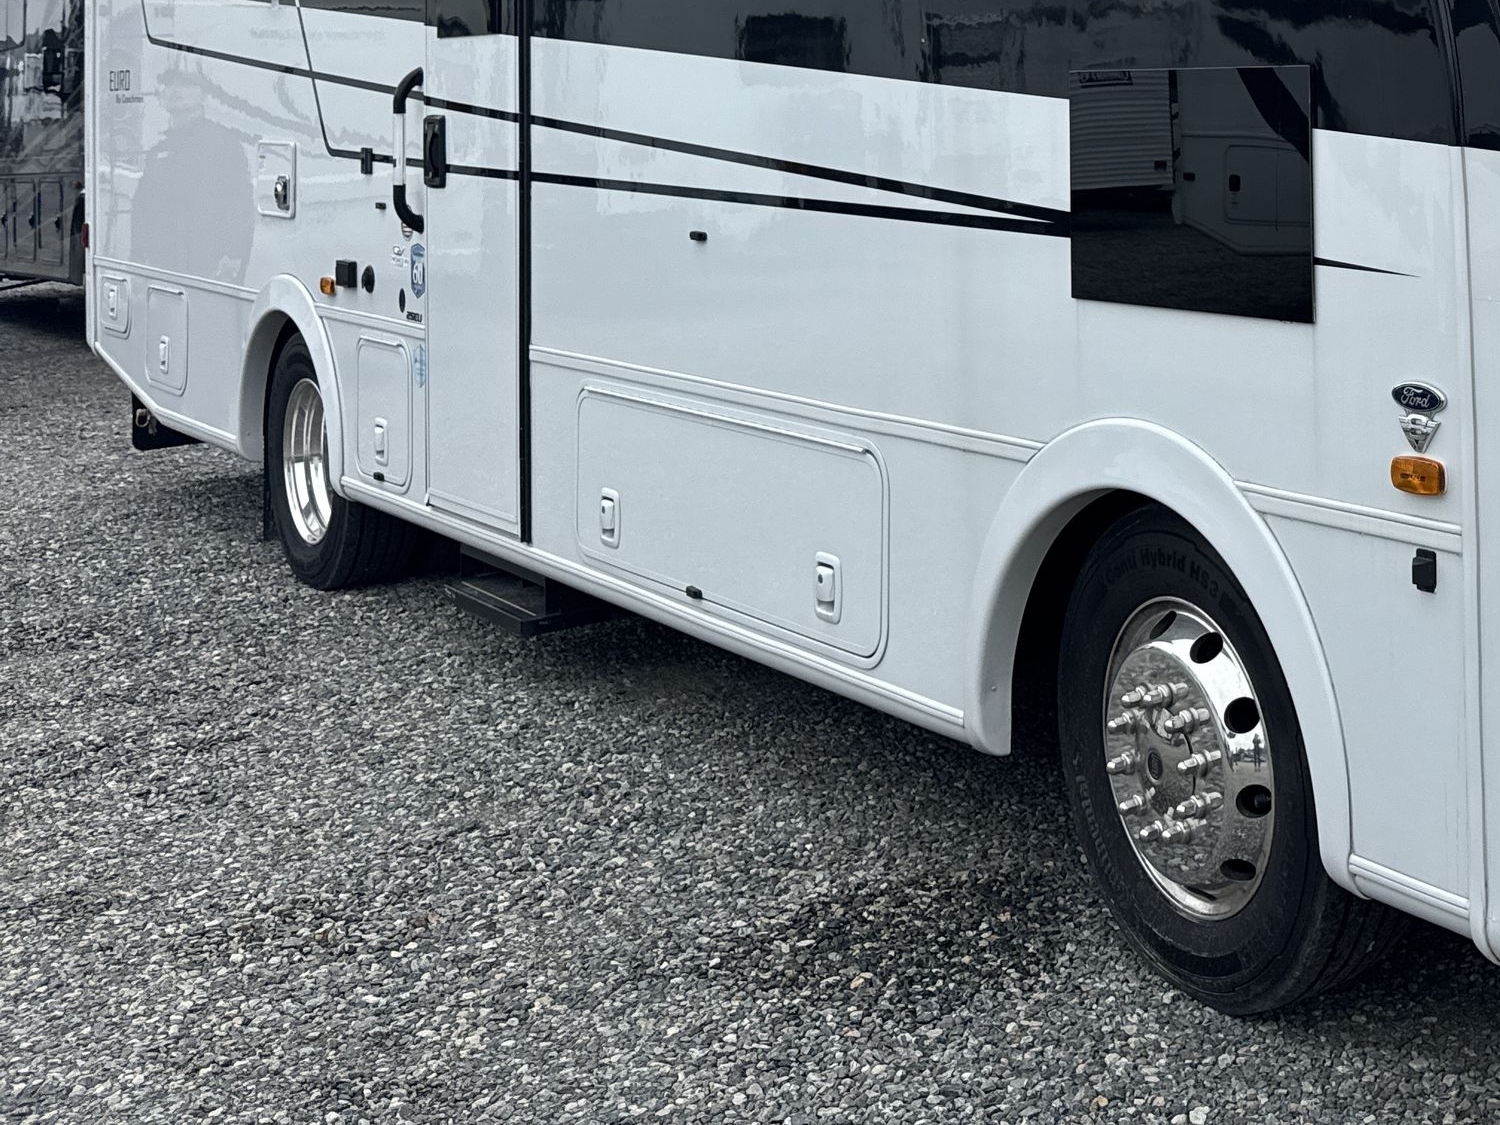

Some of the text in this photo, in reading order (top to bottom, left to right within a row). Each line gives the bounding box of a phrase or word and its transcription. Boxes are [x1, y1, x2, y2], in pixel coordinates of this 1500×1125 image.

[109, 70, 131, 92] EURO
[1400, 385, 1432, 409] Ford
[1140, 547, 1187, 573] Hybrid
